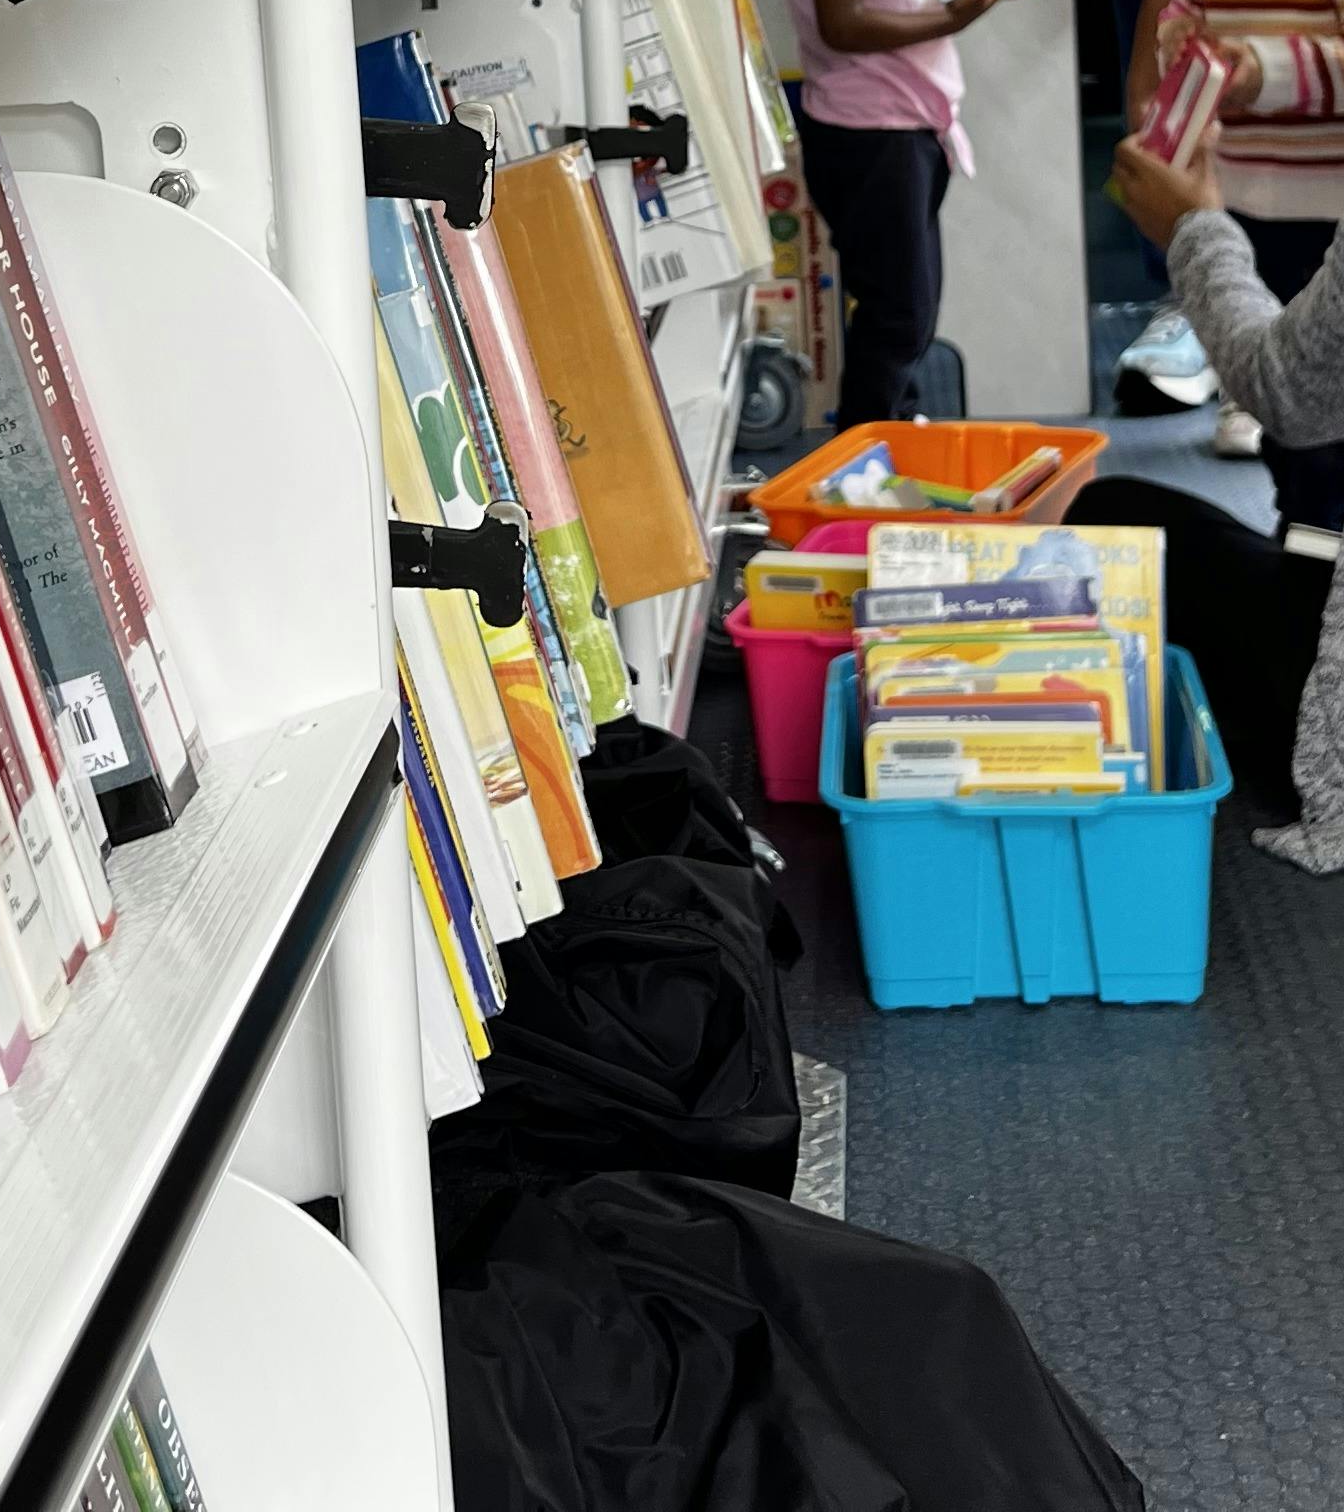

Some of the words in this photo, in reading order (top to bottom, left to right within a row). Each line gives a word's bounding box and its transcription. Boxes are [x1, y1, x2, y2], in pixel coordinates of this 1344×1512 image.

[8, 283, 59, 409] HOUSE
[9, 439, 26, 456] in
[60, 433, 91, 509] GILLY
[37, 569, 68, 587] The
